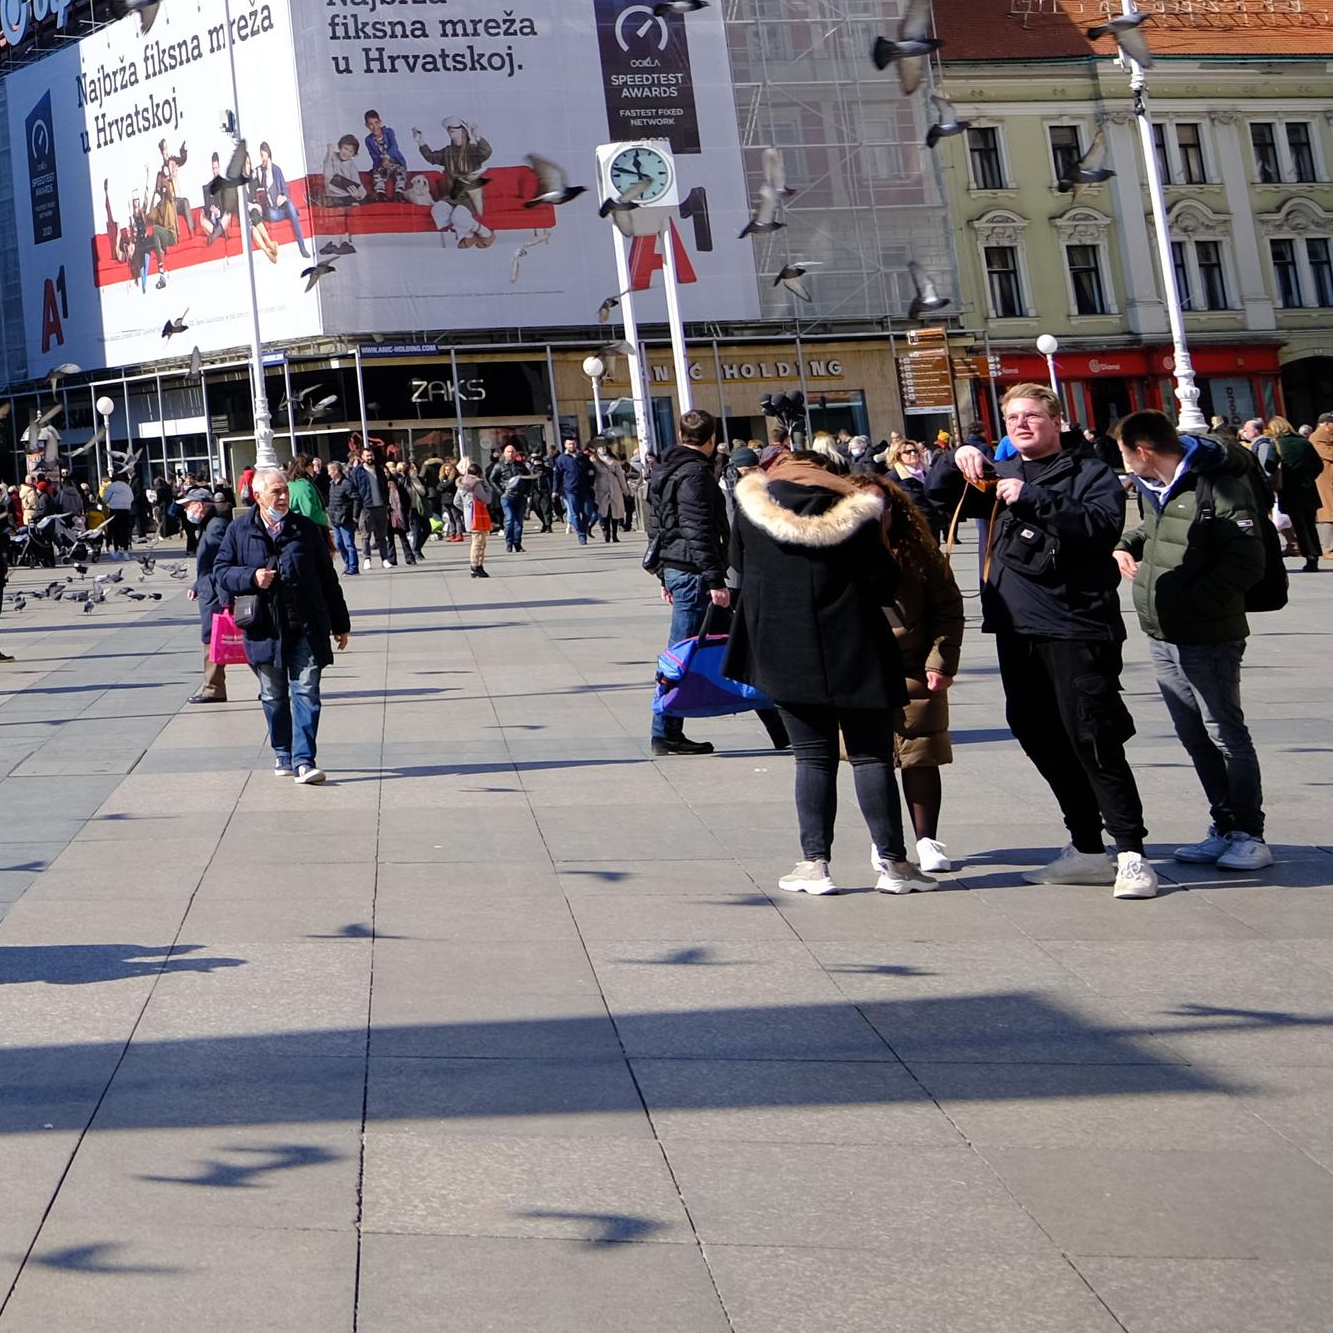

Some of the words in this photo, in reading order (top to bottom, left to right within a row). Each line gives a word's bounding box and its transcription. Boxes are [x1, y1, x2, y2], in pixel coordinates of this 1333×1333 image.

[328, 14, 430, 40] fiksna
[438, 10, 538, 39] mreža
[75, 54, 140, 109] Najbrža
[143, 39, 203, 81] fiksna
[332, 55, 353, 75] u
[362, 45, 524, 77] Hrvatskoj.
[610, 73, 684, 86] SPEEDTEST
[621, 87, 678, 98] AWARDS
[80, 130, 92, 155] u
[94, 86, 184, 149] Hrvatskoj.
[619, 109, 657, 117] FASTEST
[658, 108, 684, 116] FIXED
[630, 118, 676, 126] NETWORK
[41, 265, 68, 354] A1
[411, 379, 487, 402] ZAKS
